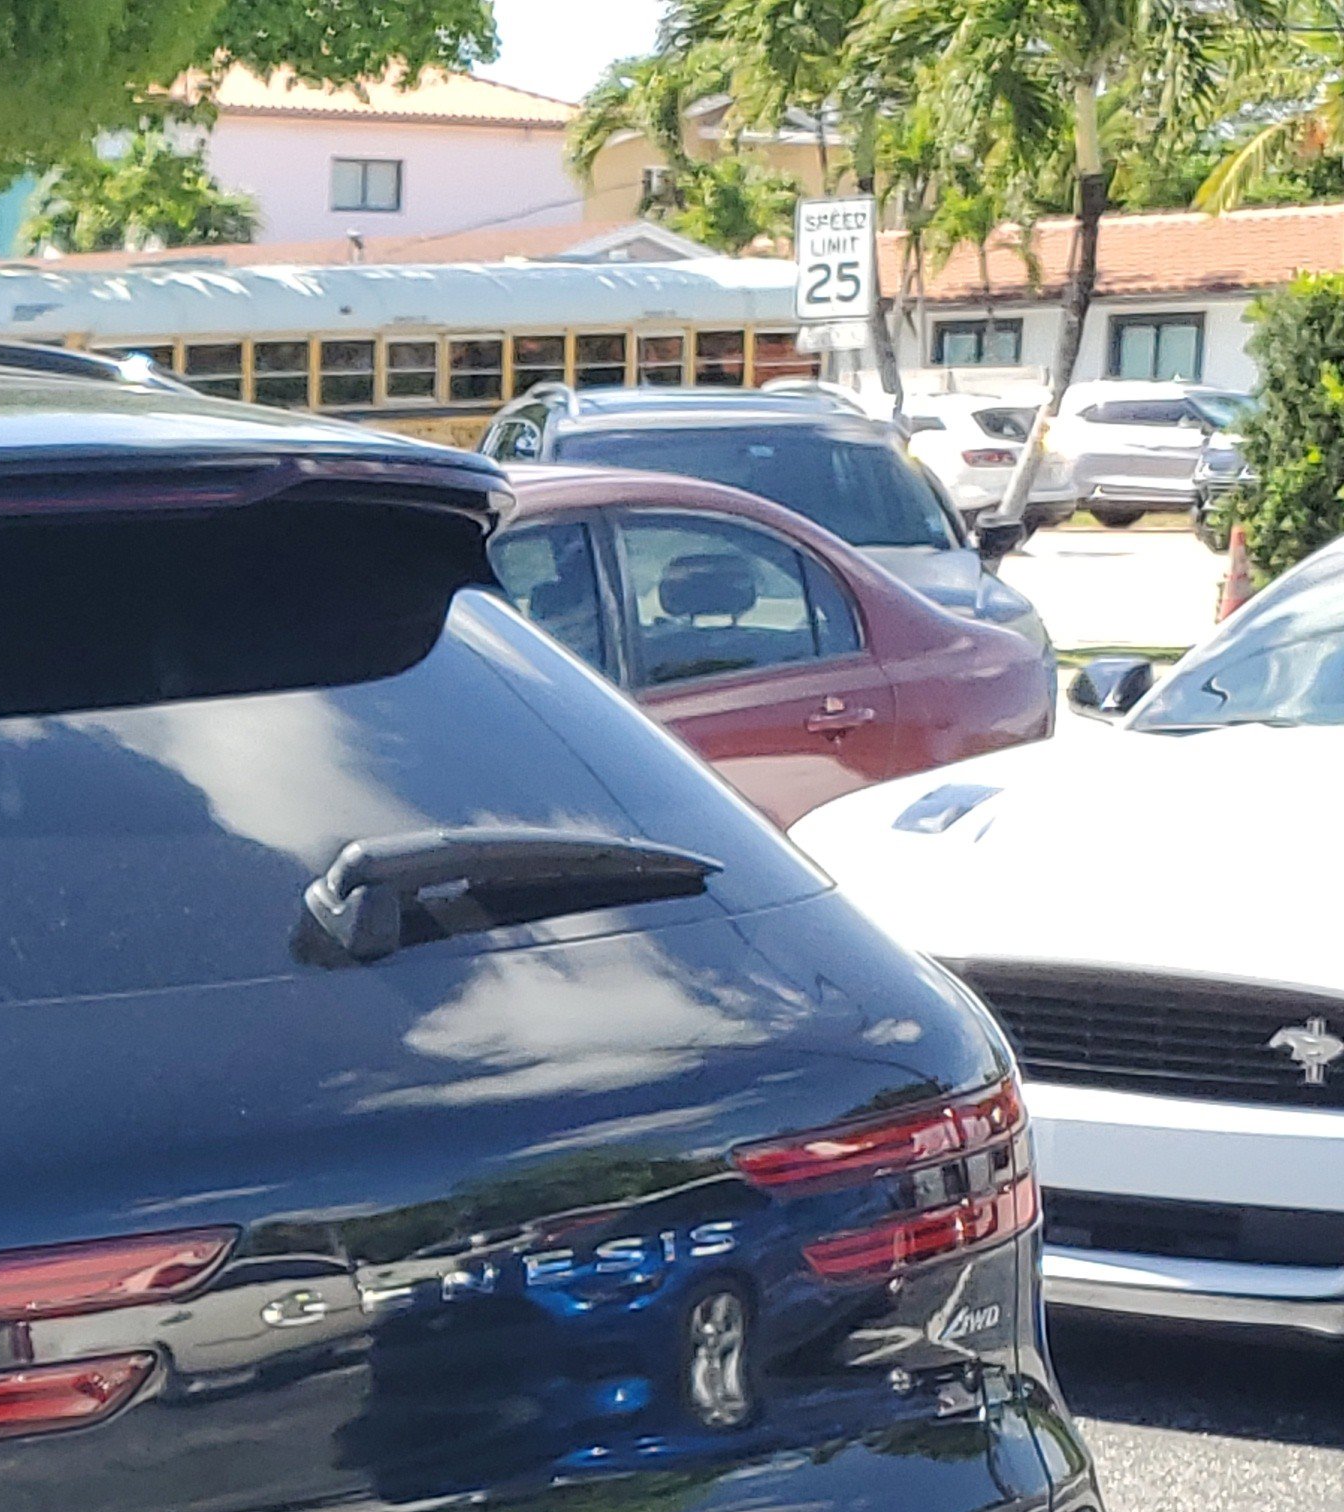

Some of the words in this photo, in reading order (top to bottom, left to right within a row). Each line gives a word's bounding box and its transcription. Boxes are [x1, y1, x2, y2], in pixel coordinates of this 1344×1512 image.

[804, 211, 867, 232] SPEED
[811, 235, 860, 257] LIMIT
[805, 260, 861, 304] 25
